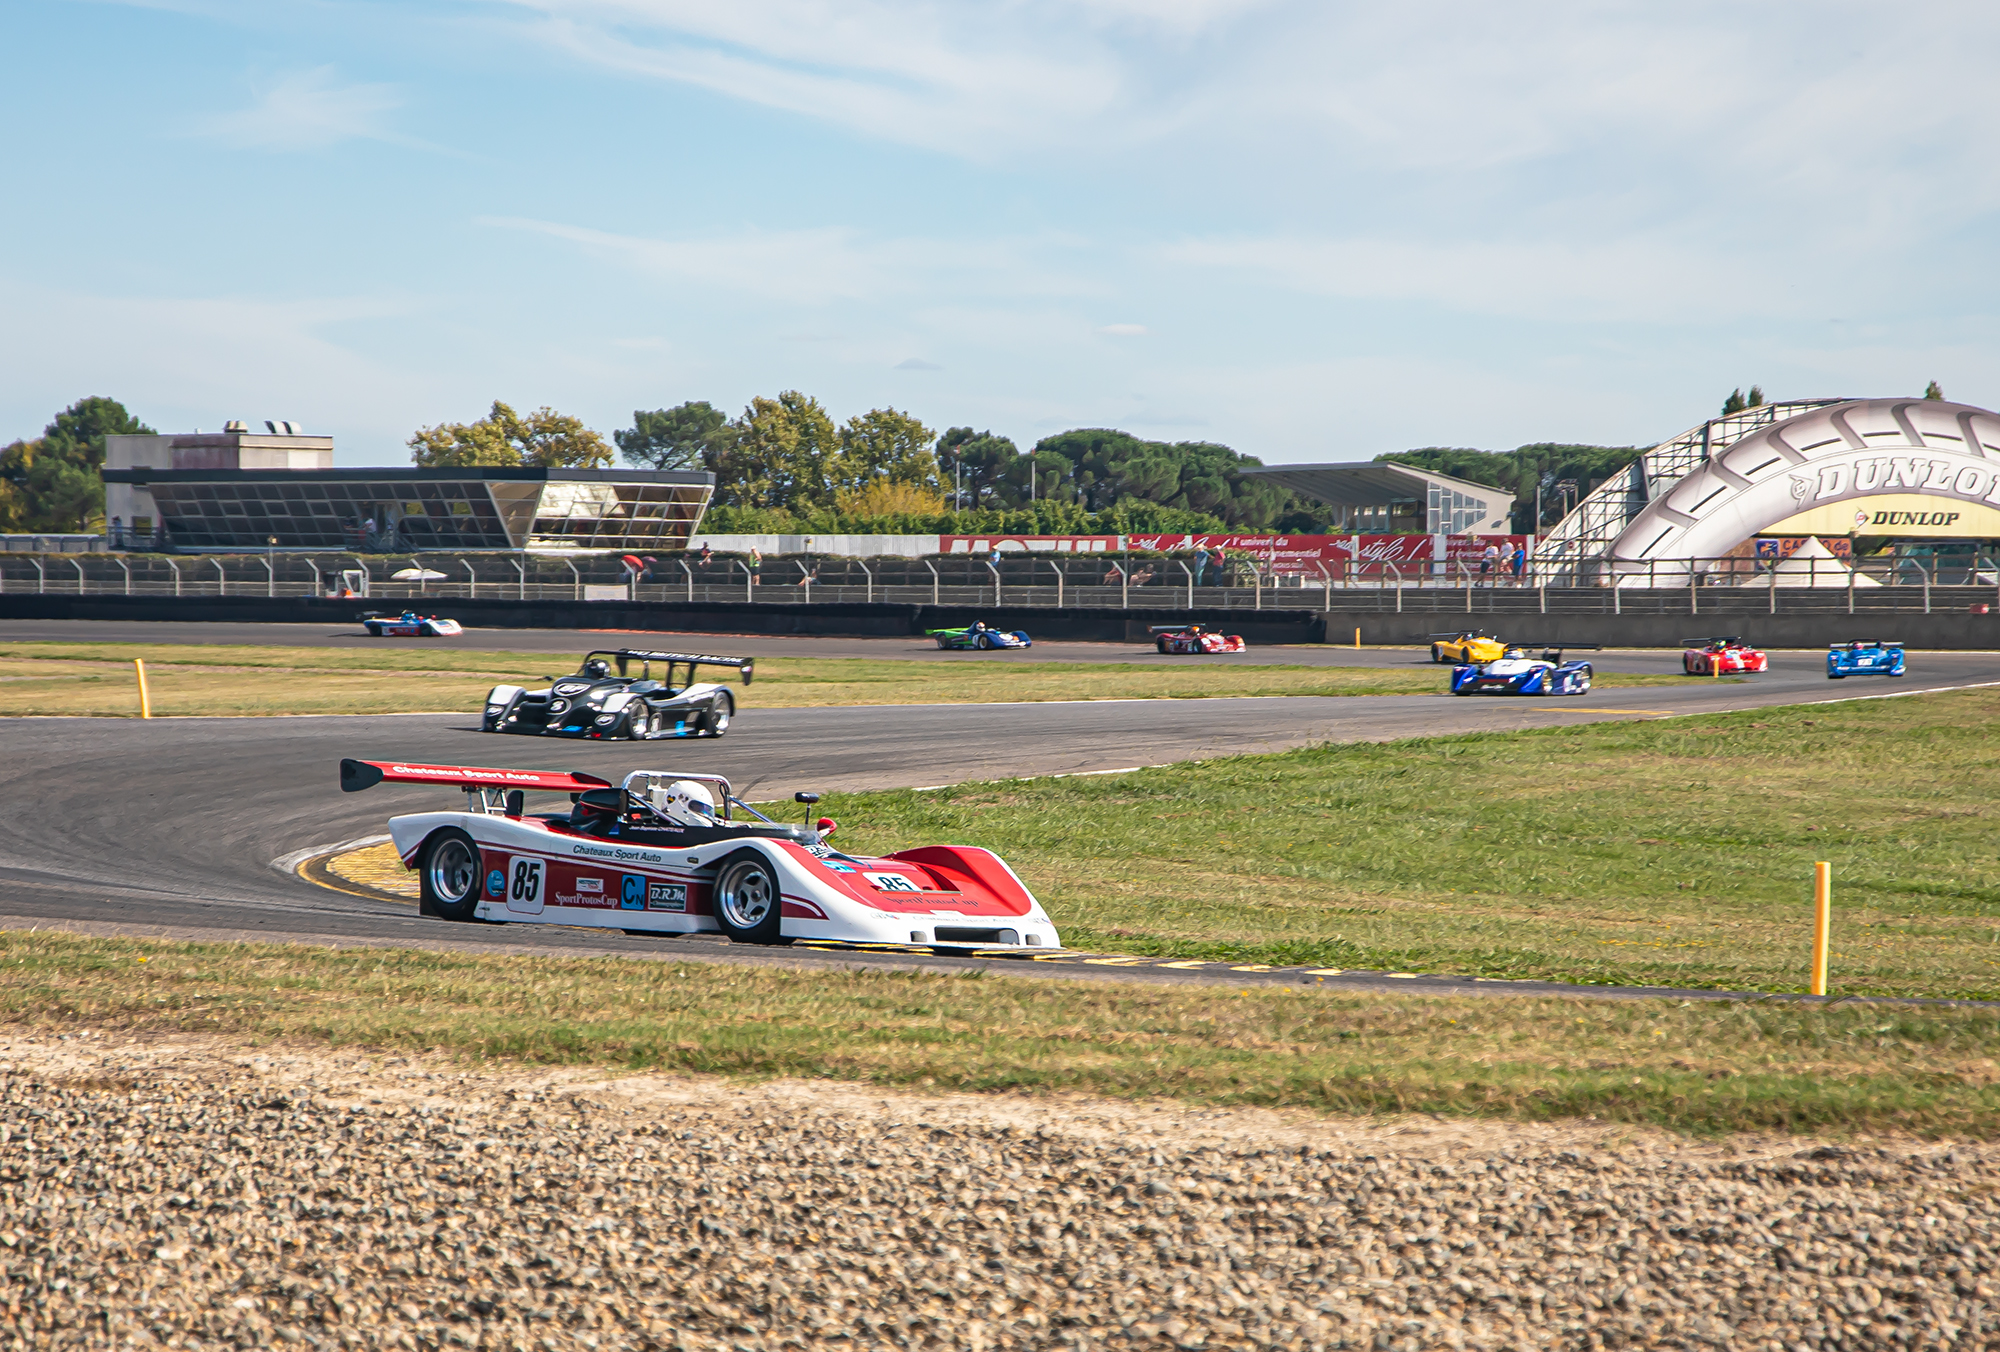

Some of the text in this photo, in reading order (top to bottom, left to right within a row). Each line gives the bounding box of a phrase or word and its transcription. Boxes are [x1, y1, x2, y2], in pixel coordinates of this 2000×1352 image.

[1872, 511, 1960, 526] DUNLOP
[1275, 537, 1289, 546] du
[1833, 539, 1849, 551] de
[393, 766, 540, 781] Chateaux Sport Auto
[573, 845, 661, 862] Chateaux Sport Auto
[512, 861, 541, 903] 85
[878, 877, 914, 891] 85
[555, 892, 617, 909] SportProtosCup
